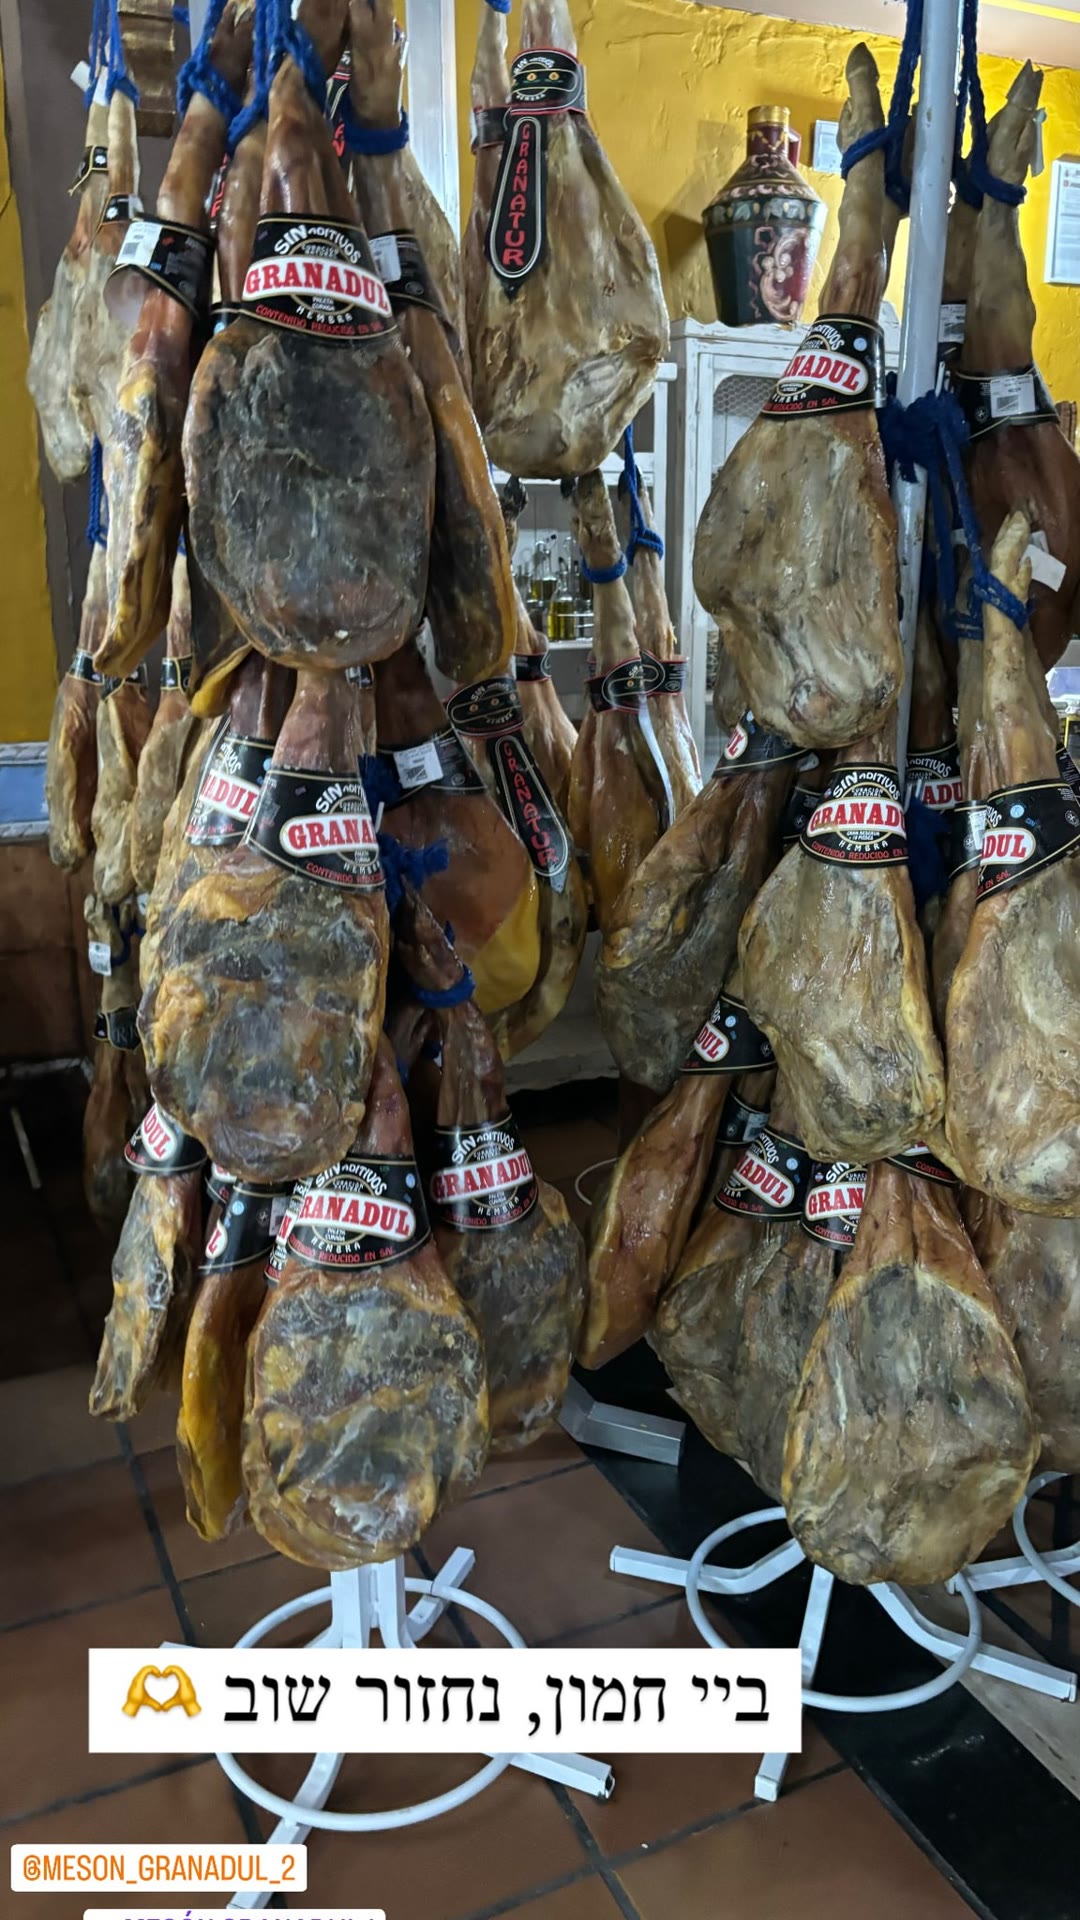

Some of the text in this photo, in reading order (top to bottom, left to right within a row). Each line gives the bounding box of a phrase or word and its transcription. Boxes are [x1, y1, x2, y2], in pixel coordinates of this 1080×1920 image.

[503, 123, 531, 266] GRANATUR
[274, 224, 307, 255] SIN
[308, 226, 361, 264] ADITIVOS
[245, 261, 391, 315] GRANADUL
[255, 304, 307, 329] CONTENIDO
[784, 354, 861, 391] NADUL
[316, 783, 343, 813] SIN
[833, 771, 900, 800] SIN ADITIVOS
[504, 742, 558, 867] GRANATUR
[810, 802, 905, 832] GRANAD
[288, 817, 376, 850] GRANA
[839, 840, 888, 852] HEMBRA
[849, 851, 889, 860] REDUCIDO
[306, 862, 353, 884] CONTENIDO
[452, 1135, 477, 1165] SIN
[316, 1162, 341, 1188] SIN
[341, 1164, 387, 1196] ADITIVOS
[738, 1155, 788, 1205] ADUL
[826, 1161, 850, 1183] SIN
[478, 1196, 520, 1216] HEMBRA
[809, 1188, 864, 1215] GRAN
[300, 1195, 411, 1239] RANADUL
[311, 1236, 361, 1254] HEMBRA
[815, 1225, 852, 1242] CONTENIDO
[318, 1251, 360, 1262] REDUCIDO
[364, 1251, 376, 1260] EN
